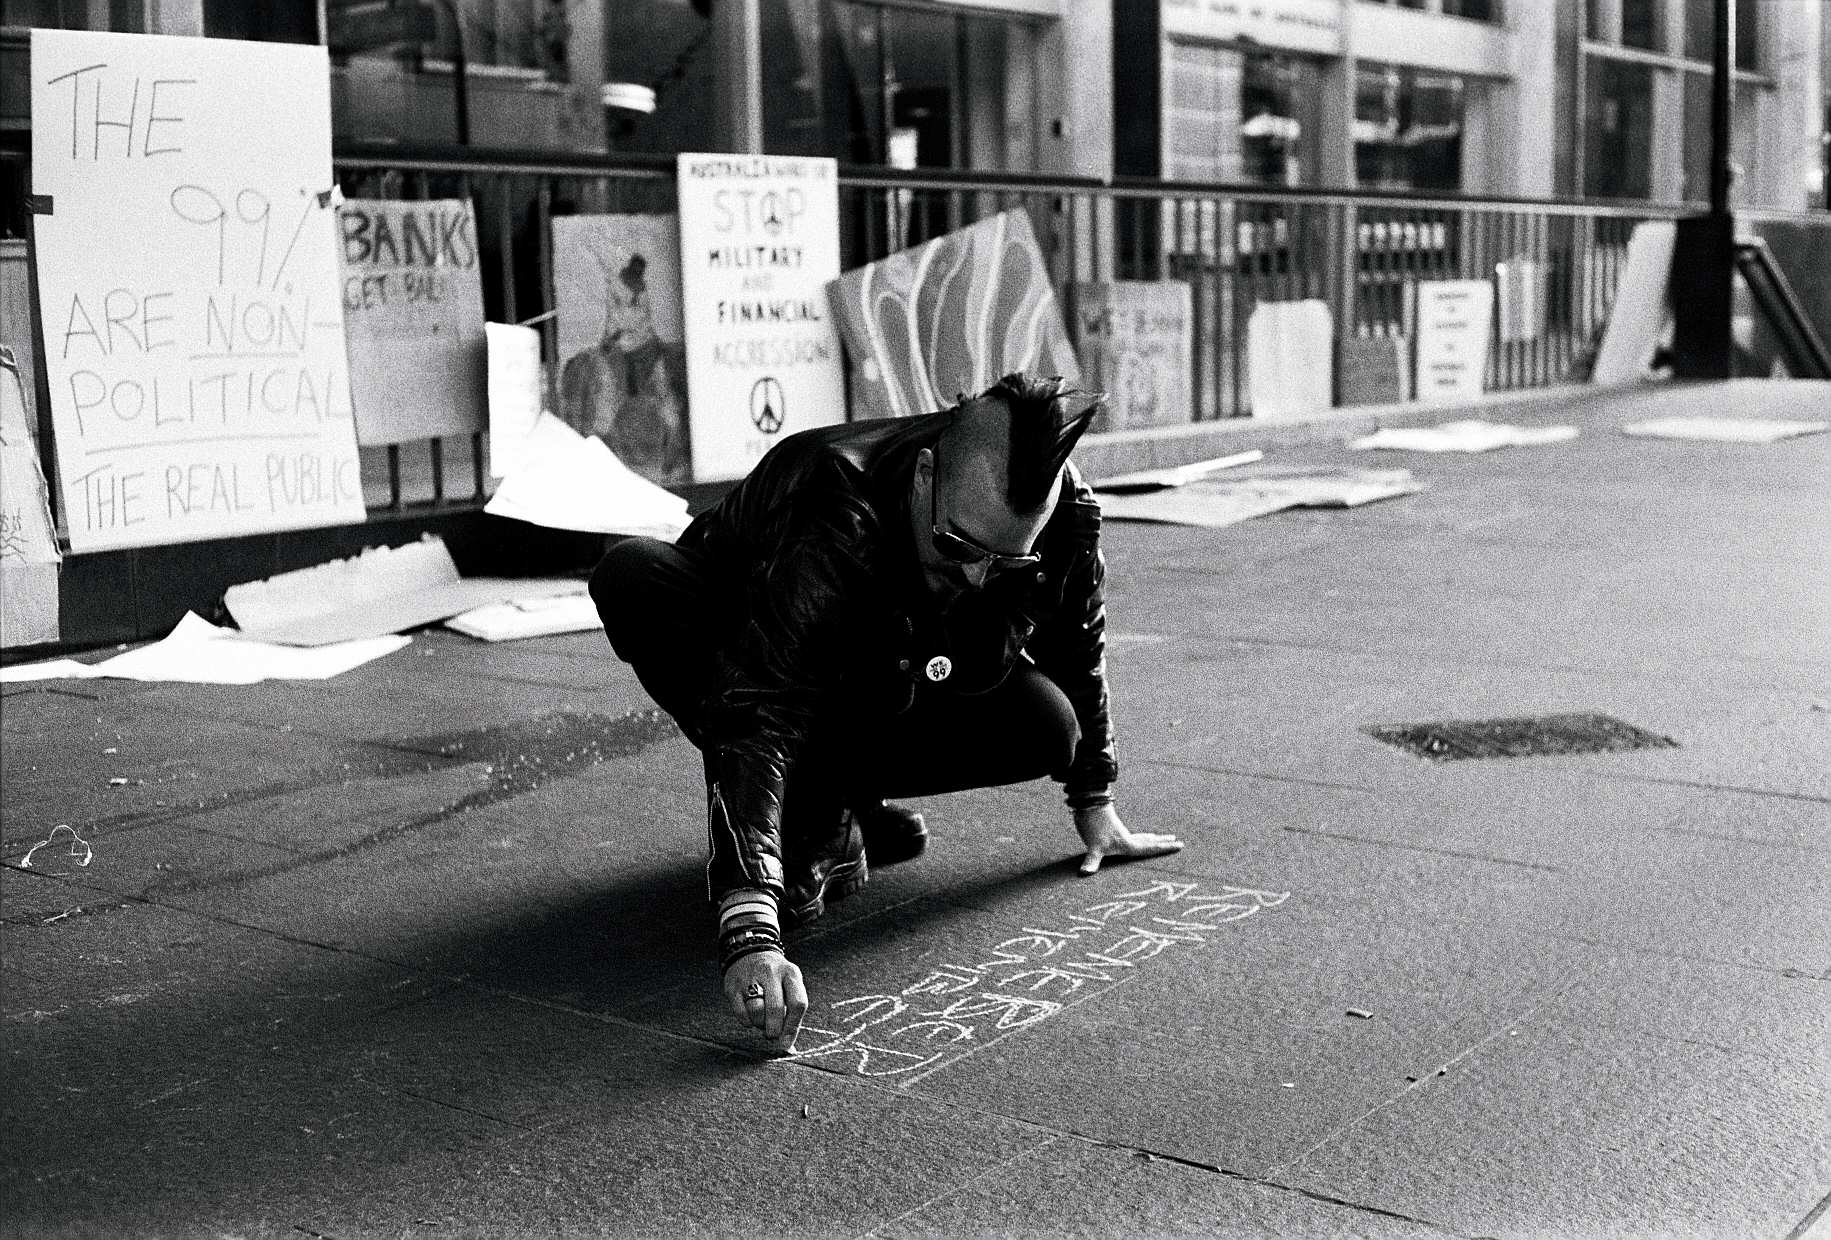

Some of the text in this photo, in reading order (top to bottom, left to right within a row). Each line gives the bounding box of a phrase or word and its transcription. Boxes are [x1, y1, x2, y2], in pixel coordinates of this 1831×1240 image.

[48, 64, 197, 161] THE
[690, 159, 771, 180] AUSTRALIA
[171, 185, 316, 295] 99%
[341, 211, 475, 270] BANKS
[713, 186, 808, 237] STOP
[708, 246, 804, 269] MILITARY
[64, 288, 175, 359] ARE
[717, 301, 821, 325] FINANCIAL
[69, 366, 352, 437] POLITICAL
[71, 464, 146, 530] THE
[166, 463, 255, 519] REAL
[266, 452, 357, 514] PUBLIC
[932, 667, 946, 680] 99
